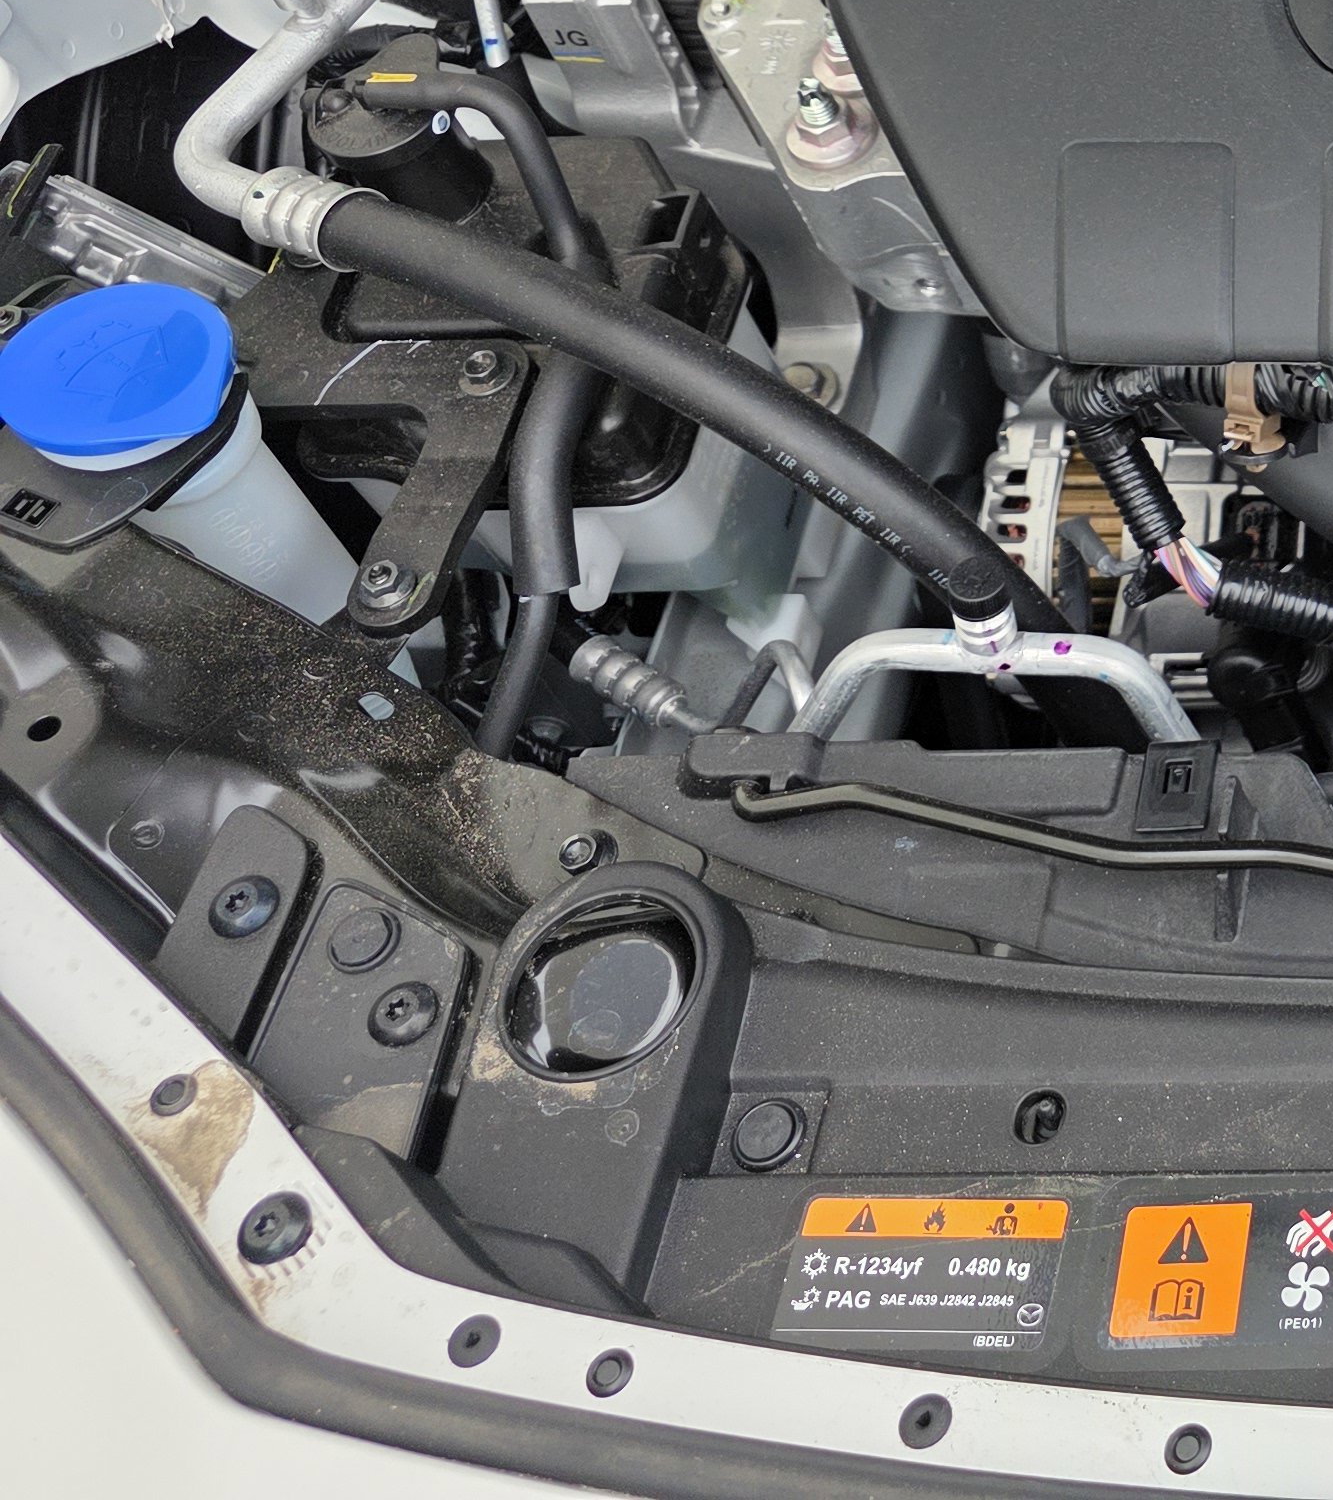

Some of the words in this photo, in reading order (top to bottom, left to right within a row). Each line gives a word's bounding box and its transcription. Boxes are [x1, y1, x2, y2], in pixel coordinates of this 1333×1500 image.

[554, 29, 589, 47] JG
[833, 1256, 925, 1279] R-1234yf
[948, 1257, 1001, 1277] 0.480
[1005, 1258, 1031, 1281] kg
[825, 1290, 872, 1309] PAG
[879, 1294, 907, 1306] SAE
[908, 1294, 938, 1306] J639
[940, 1294, 977, 1306] J2842
[977, 1295, 1015, 1307] J2845
[1279, 1317, 1322, 1330] (PE01)
[972, 1335, 1015, 1347] (BDEL)
